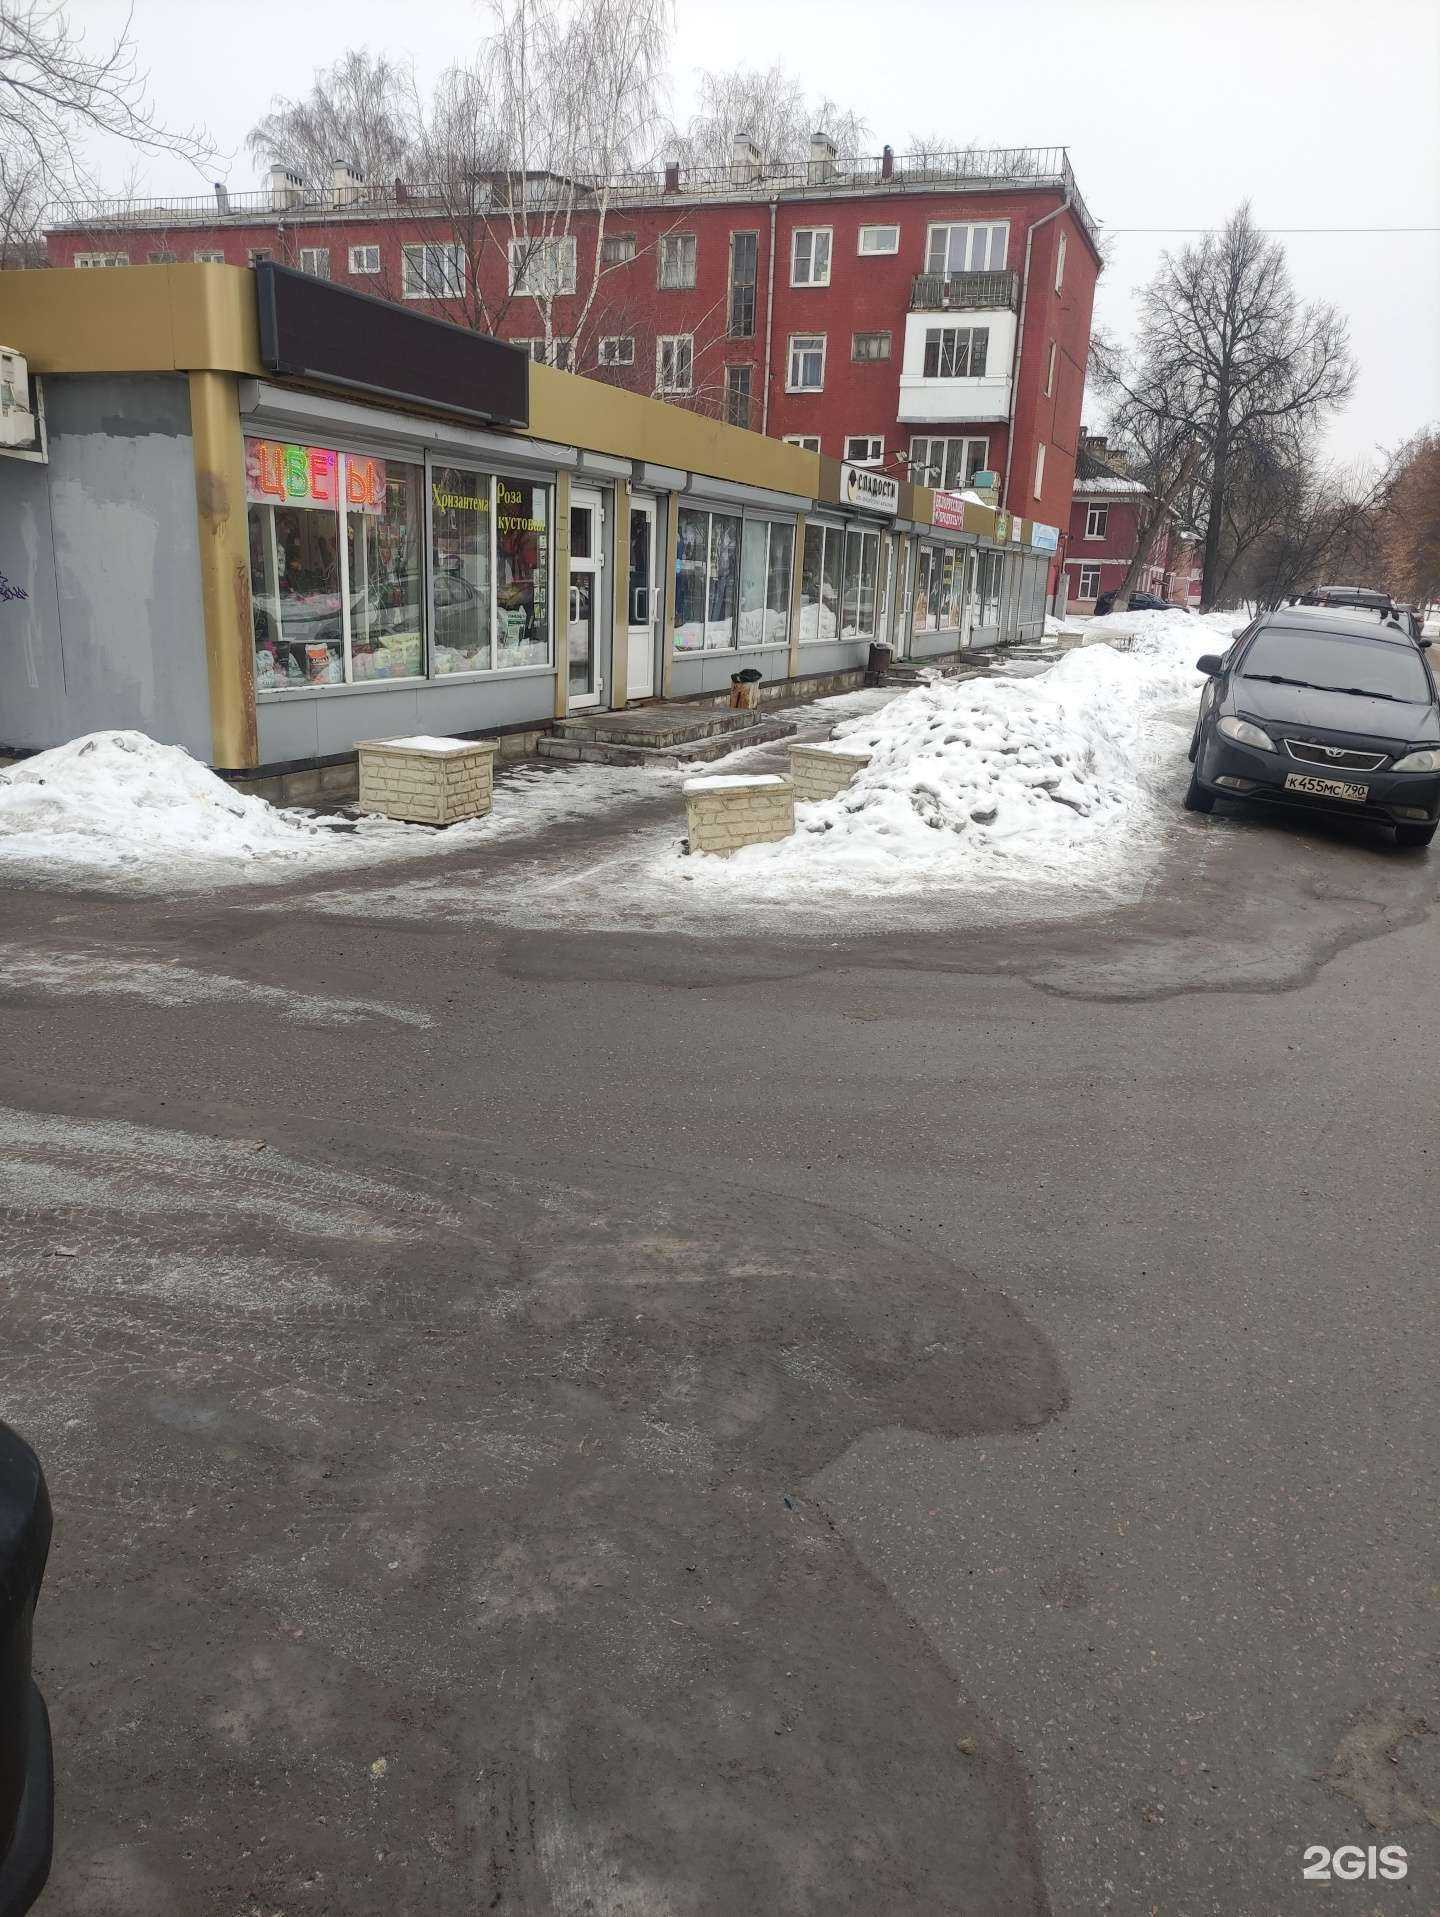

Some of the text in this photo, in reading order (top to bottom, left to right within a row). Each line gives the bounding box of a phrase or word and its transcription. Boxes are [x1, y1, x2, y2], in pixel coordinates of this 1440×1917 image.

[257, 443, 375, 505] ЦВЕЫ
[857, 473, 897, 499] СЛАДОСТИ
[432, 483, 489, 513] Хризантема
[496, 482, 522, 504] Роза
[1344, 784, 1365, 796] 790
